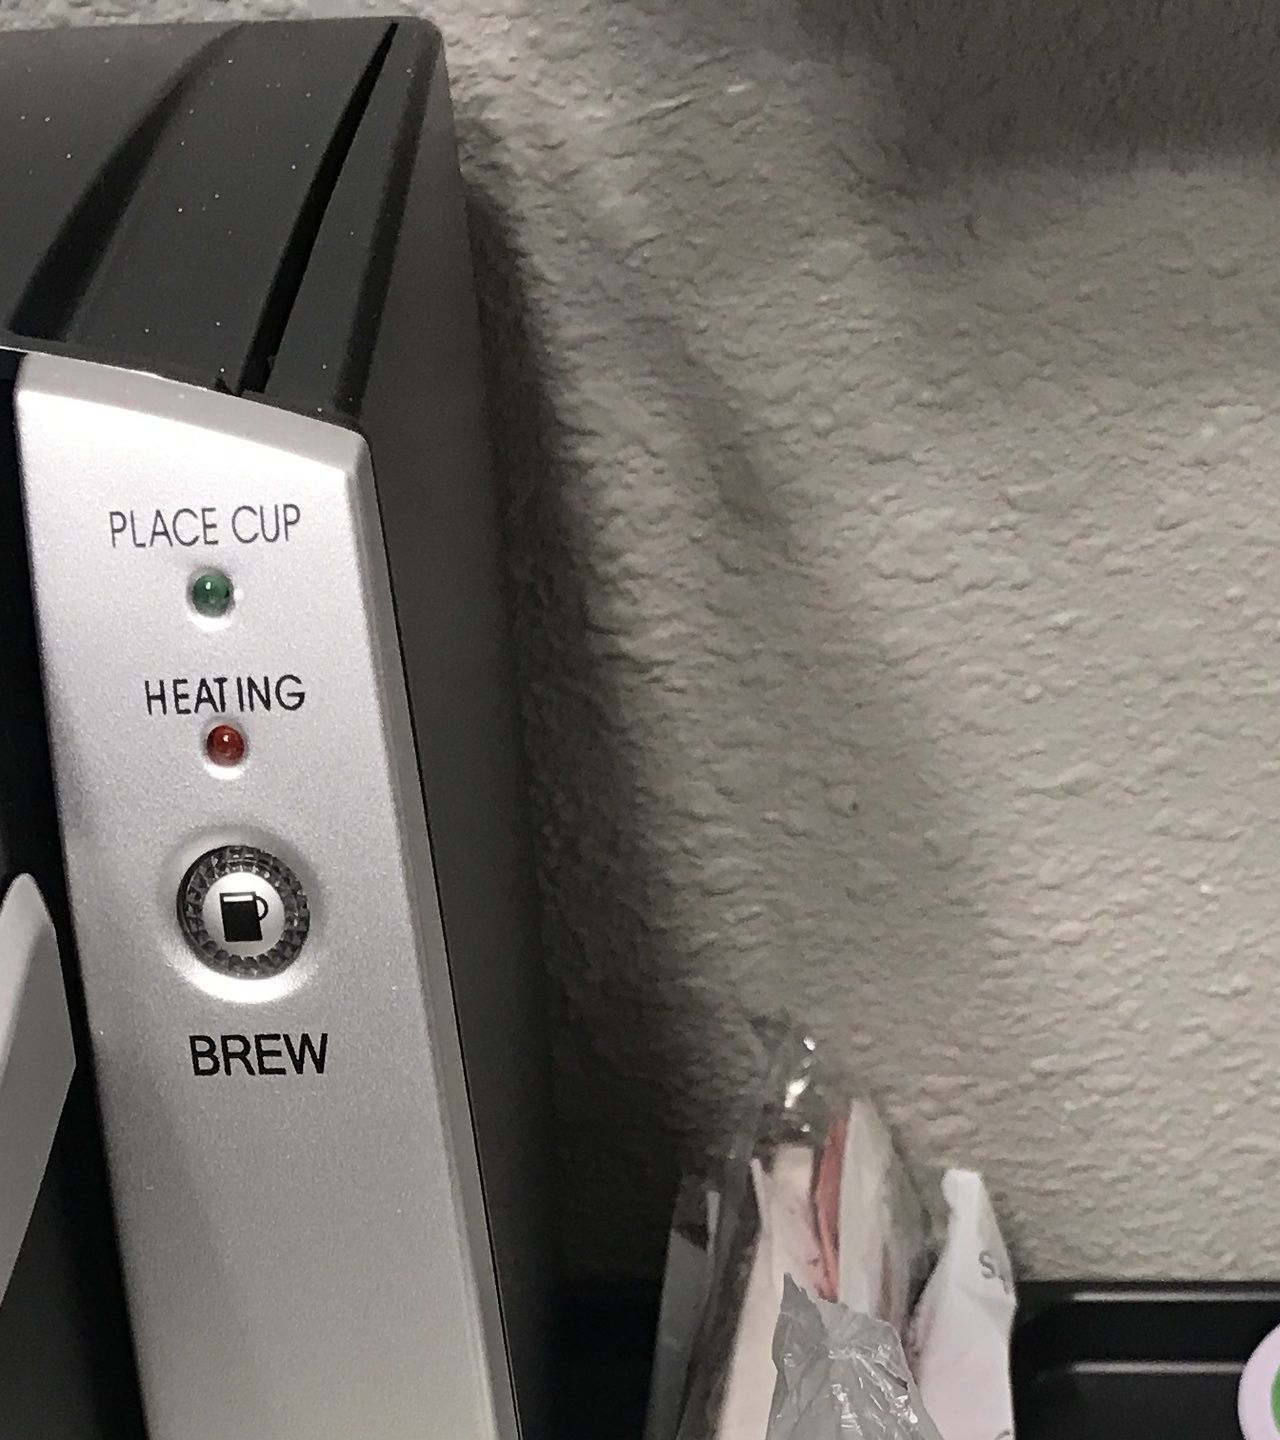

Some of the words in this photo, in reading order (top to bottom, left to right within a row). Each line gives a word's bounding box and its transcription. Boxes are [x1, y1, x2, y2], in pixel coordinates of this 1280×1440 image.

[108, 506, 218, 549] PLACE
[230, 502, 301, 544] CUP
[144, 673, 306, 715] HEATING
[188, 1032, 329, 1077] BREW
